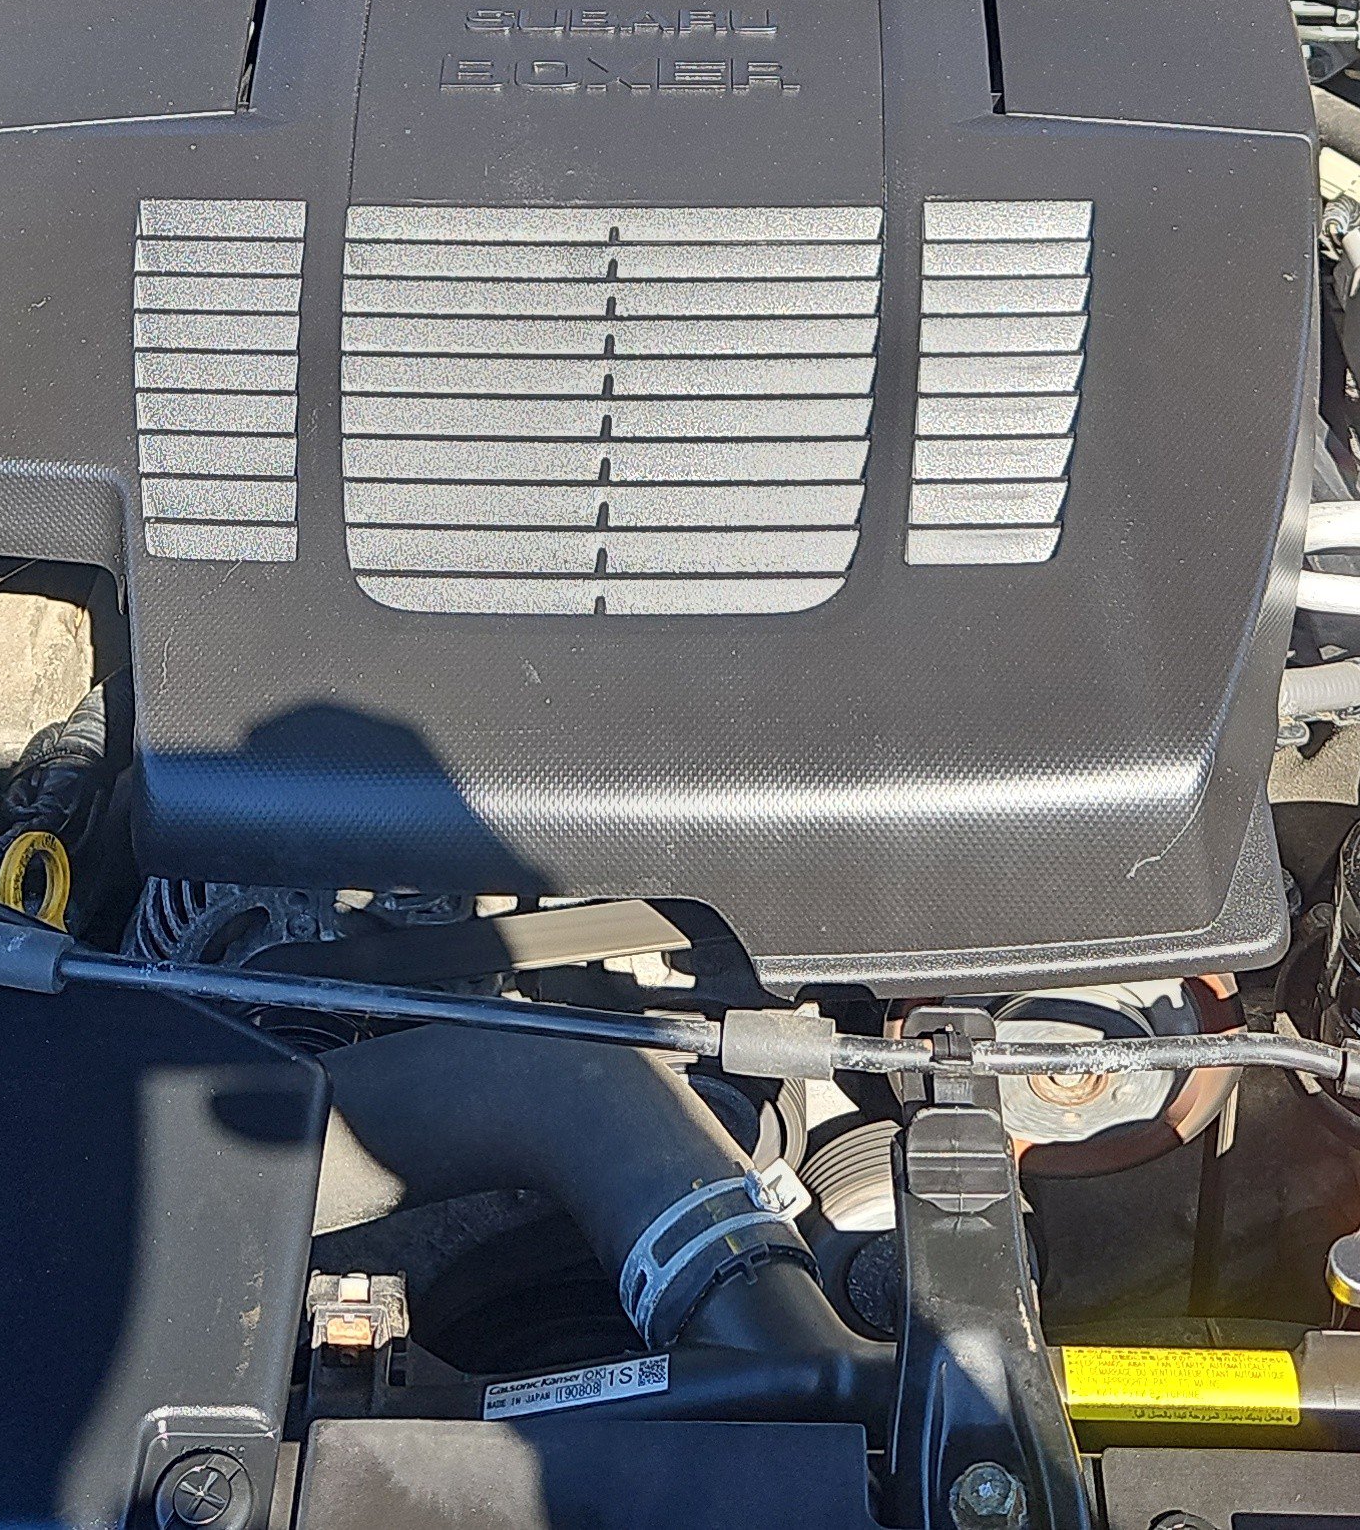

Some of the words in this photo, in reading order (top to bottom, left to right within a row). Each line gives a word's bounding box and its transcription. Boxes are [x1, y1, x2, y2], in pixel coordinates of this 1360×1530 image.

[464, 9, 777, 35] SUBARU
[439, 57, 801, 91] BOXER
[608, 1367, 633, 1386] 1S
[487, 1398, 506, 1409] MADE
[511, 1396, 521, 1406] IN
[525, 1391, 550, 1403] JAPAN
[558, 1383, 601, 1402] 190808
